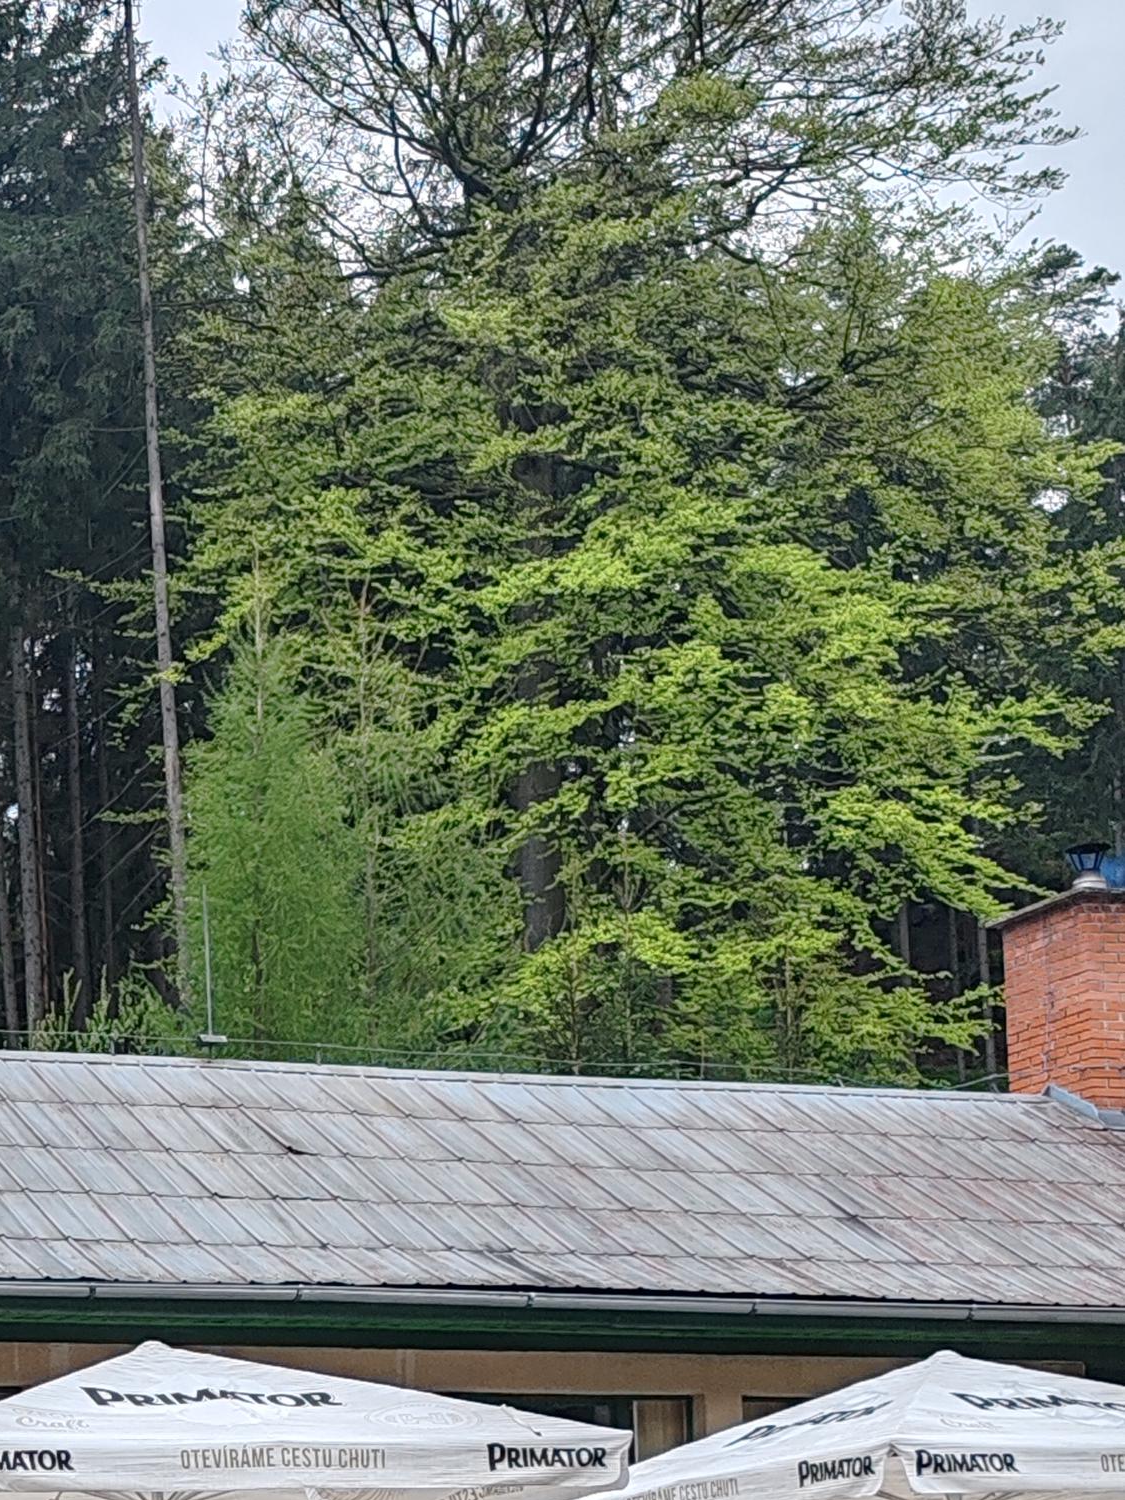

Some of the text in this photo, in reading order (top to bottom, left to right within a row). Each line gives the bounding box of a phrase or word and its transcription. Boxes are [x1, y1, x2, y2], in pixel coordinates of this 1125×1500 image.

[180, 1444, 386, 1470] OTEVÍRÁME CESTU CHUTI
[486, 1442, 608, 1471] PRIMATOR
[915, 1449, 1020, 1477] PRIMATOR
[798, 1454, 876, 1488] PRIMATOR
[710, 1477, 740, 1498] CHUTI
